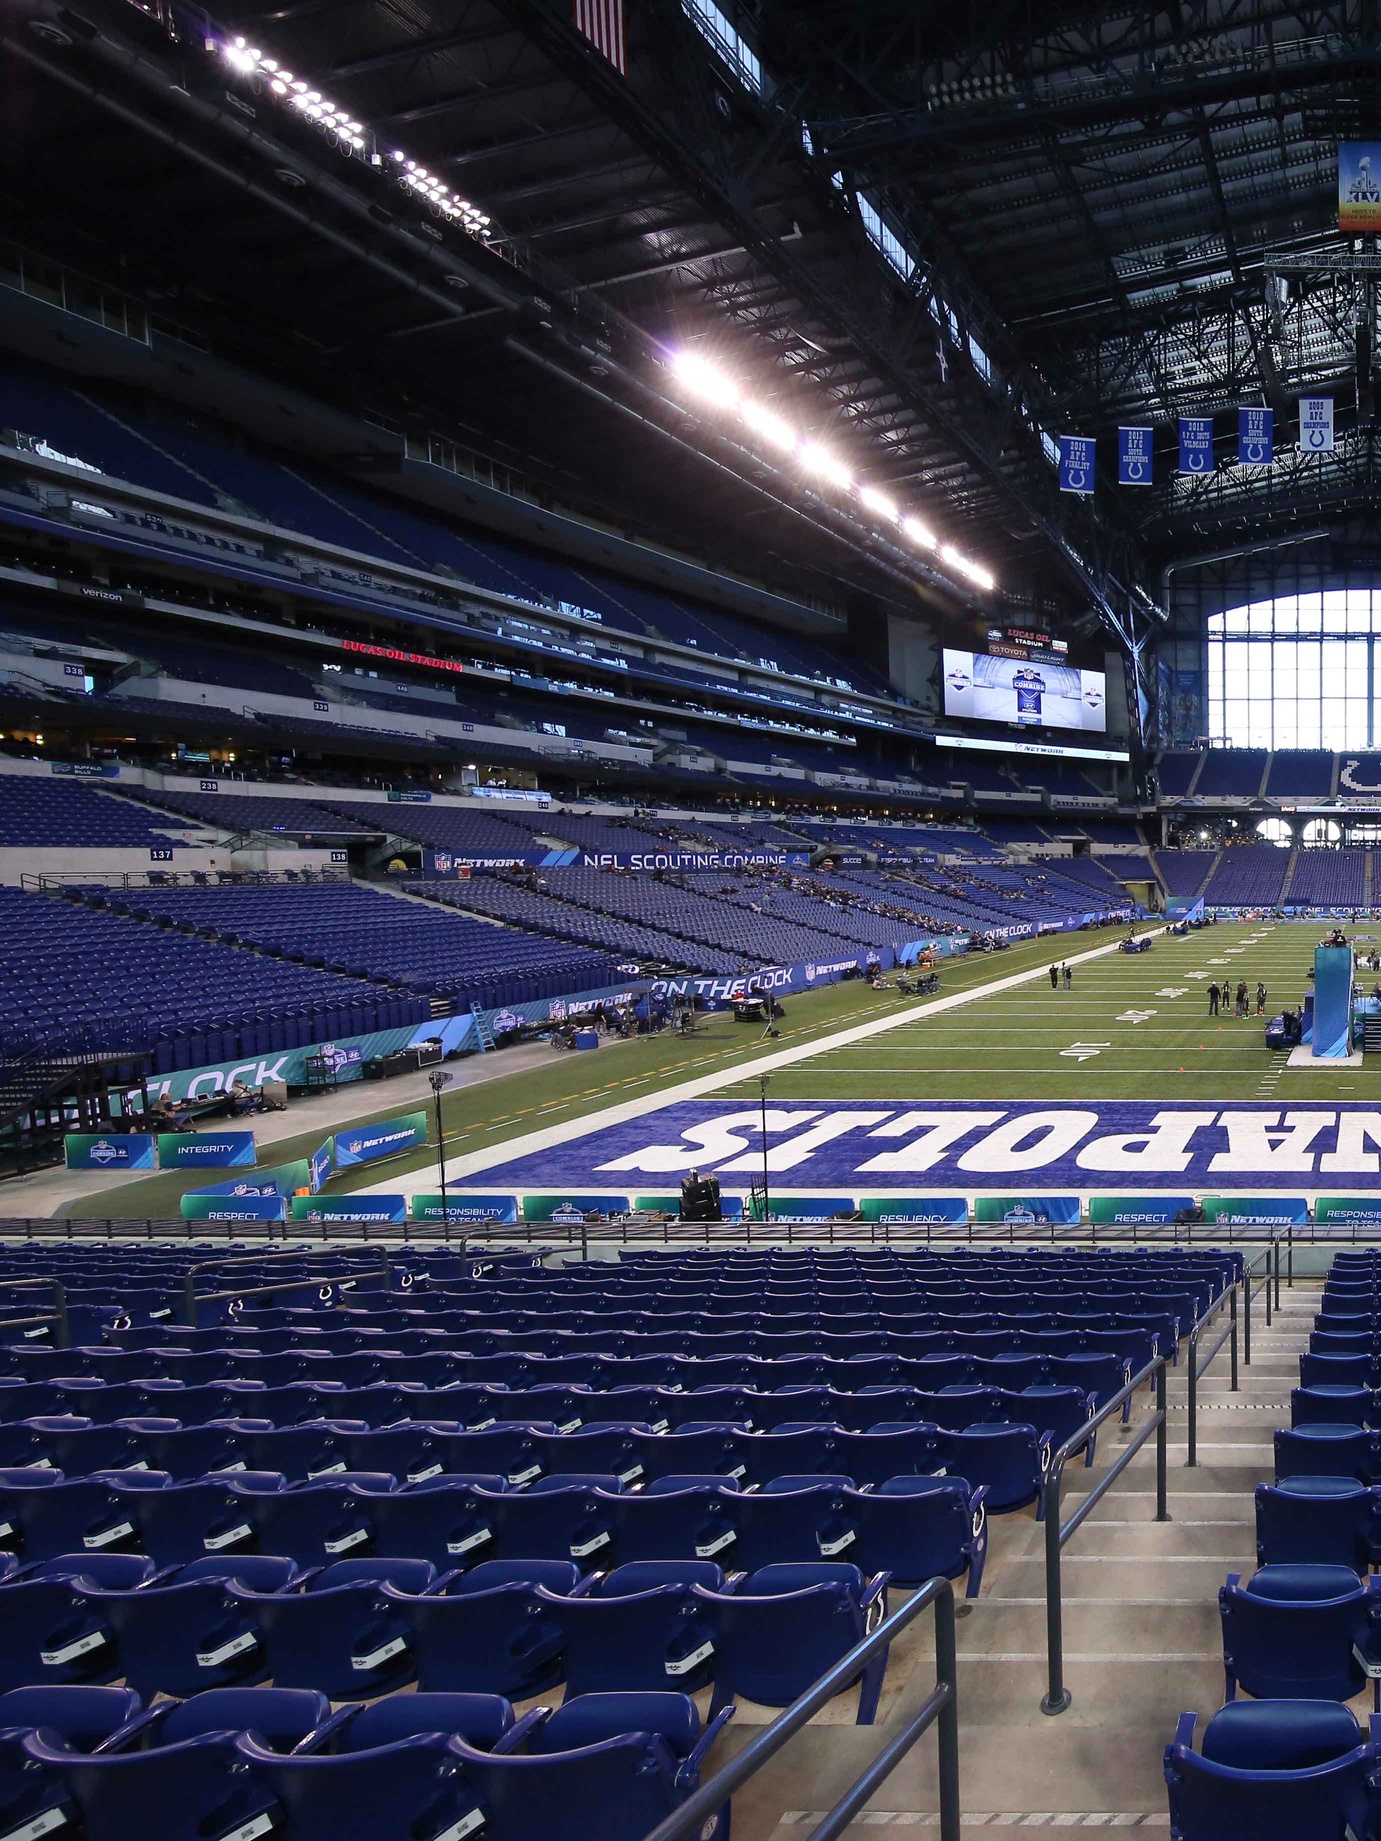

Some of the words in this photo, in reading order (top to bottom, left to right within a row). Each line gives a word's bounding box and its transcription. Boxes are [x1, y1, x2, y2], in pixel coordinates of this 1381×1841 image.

[1248, 412, 1264, 420] 2010
[1309, 411, 1323, 420] AFC
[1188, 422, 1204, 431] 2012
[1248, 421, 1263, 430] AFC
[1303, 421, 1330, 429] CHAMPIONS
[1128, 430, 1143, 439] 2013
[1182, 431, 1194, 439] AFC
[1196, 432, 1211, 440] SOUTH
[1128, 439, 1143, 448] AFC
[1183, 440, 1209, 448] WILDCARD
[1242, 437, 1268, 445] CHAMPIONS
[1070, 441, 1086, 451] 2014
[1070, 451, 1087, 460] AFC
[1122, 455, 1148, 463] CHAMPIONS
[1064, 460, 1090, 470] FINALIST
[82, 587, 123, 602] verizon
[1007, 629, 1034, 641] LUCAS
[1036, 633, 1051, 643] OIL
[1015, 638, 1043, 648] STADIUM
[343, 640, 383, 657] LUCAS
[386, 649, 406, 662] OIL
[409, 654, 463, 672] STADIUM
[1001, 647, 1028, 657] TOYOTA
[65, 665, 83, 675] 338
[1014, 681, 1045, 691] COMBINE
[314, 703, 328, 711] 339
[1024, 746, 1064, 754] NETWORK
[201, 781, 217, 790] 238
[152, 850, 171, 859] 137
[332, 853, 347, 861] 138
[453, 858, 525, 868] NETWORK
[584, 854, 638, 870] NFL
[641, 853, 719, 871] SCOUTING
[724, 854, 786, 867] COMBINE
[997, 927, 1009, 938] THE
[1009, 923, 1032, 937] CLOCK
[816, 959, 858, 976] NETWORK
[651, 980, 689, 998] ON
[693, 978, 747, 1000] THE
[747, 967, 793, 994] CLOCK
[1058, 1042, 1112, 1057] 10
[363, 1127, 416, 1149] NETWORK
[178, 1144, 234, 1154] INTEGRITY
[208, 1211, 259, 1221] RESPECT
[323, 1212, 391, 1221] NETWORK
[424, 1207, 504, 1217] RESPONSIBILITY
[879, 1215, 947, 1223] RESILIENCY
[1114, 1213, 1168, 1222] RESPECT
[1230, 1216, 1293, 1224] NETWORK
